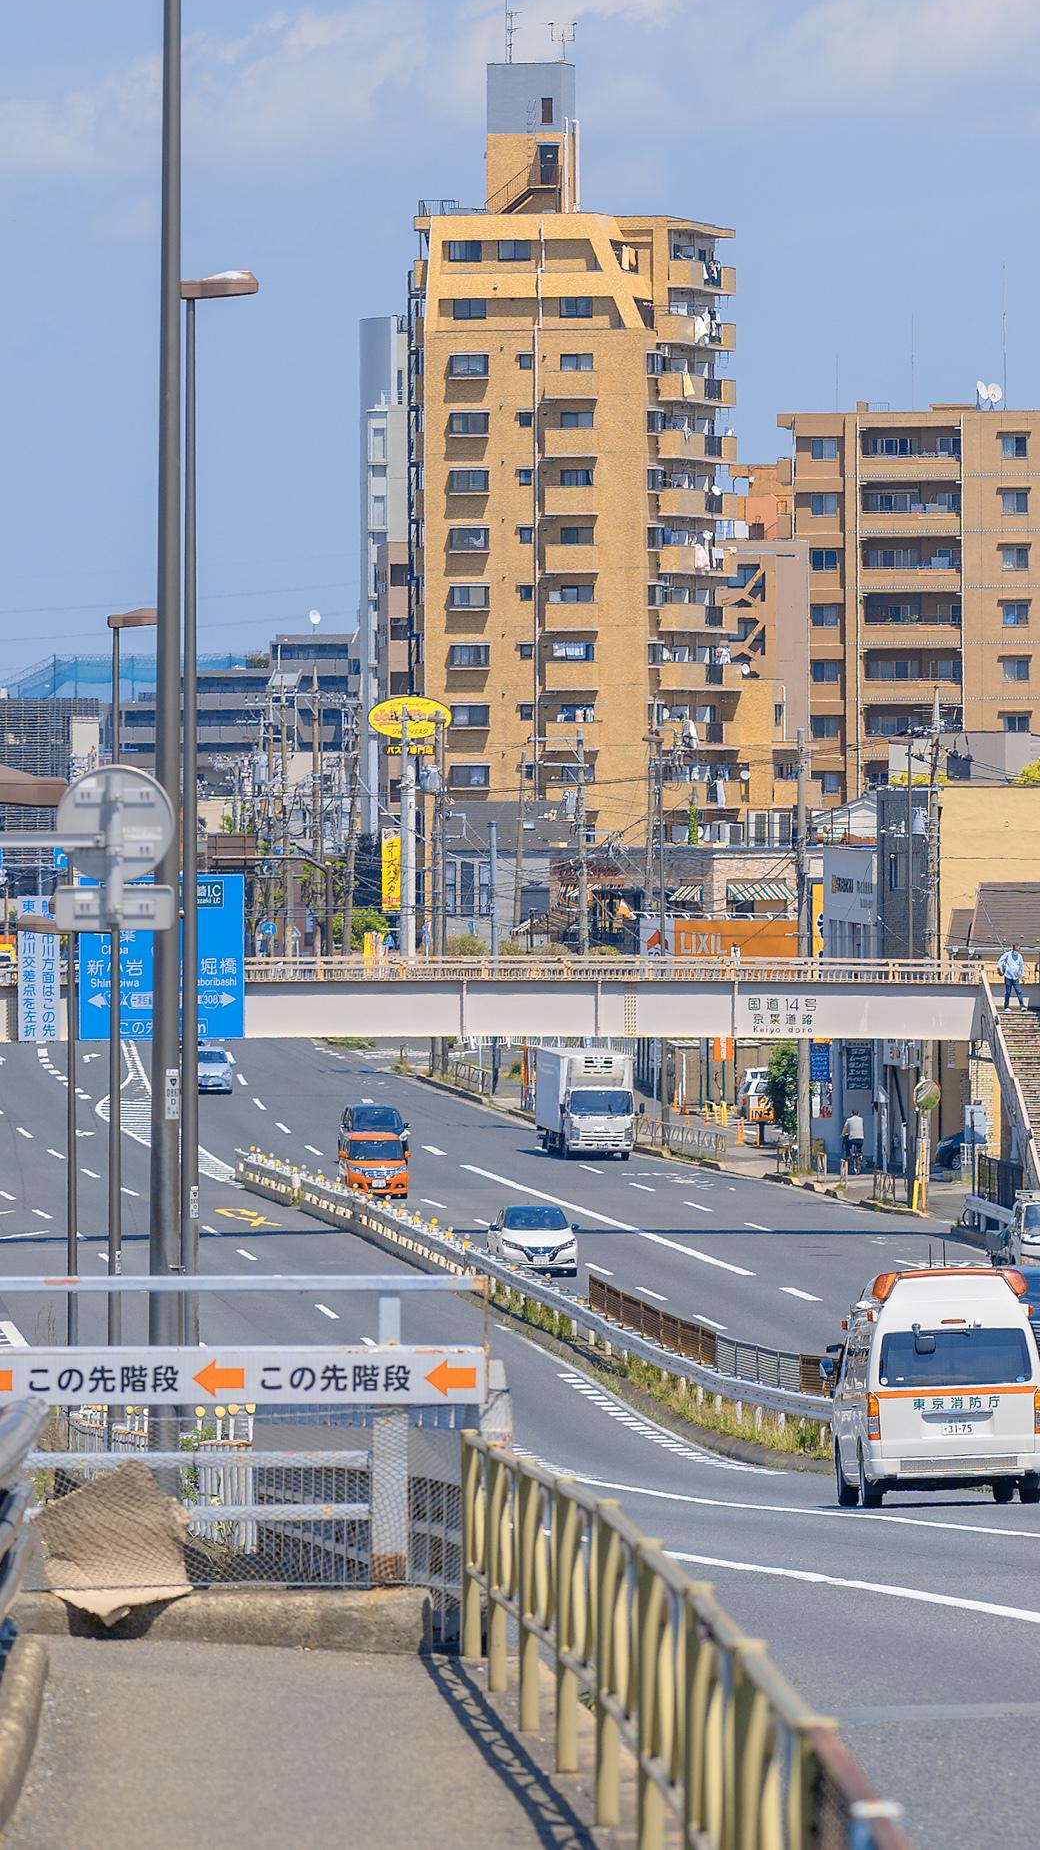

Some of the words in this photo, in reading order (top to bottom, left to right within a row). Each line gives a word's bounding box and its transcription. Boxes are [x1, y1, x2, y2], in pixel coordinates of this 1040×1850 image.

[680, 932, 727, 955] LIXIL
[22, 899, 37, 1038] 東松川交差点を左折
[41, 900, 56, 1038] 船市川方面はこの先
[200, 957, 237, 975] 堀橋
[90, 979, 140, 988] Shinoiwa
[748, 997, 817, 1011] 国道14号
[751, 1110, 763, 1119] IN
[28, 1365, 180, 1393] この先階段
[260, 1364, 412, 1392] この先階段
[913, 1395, 1001, 1410] 東京消防庁
